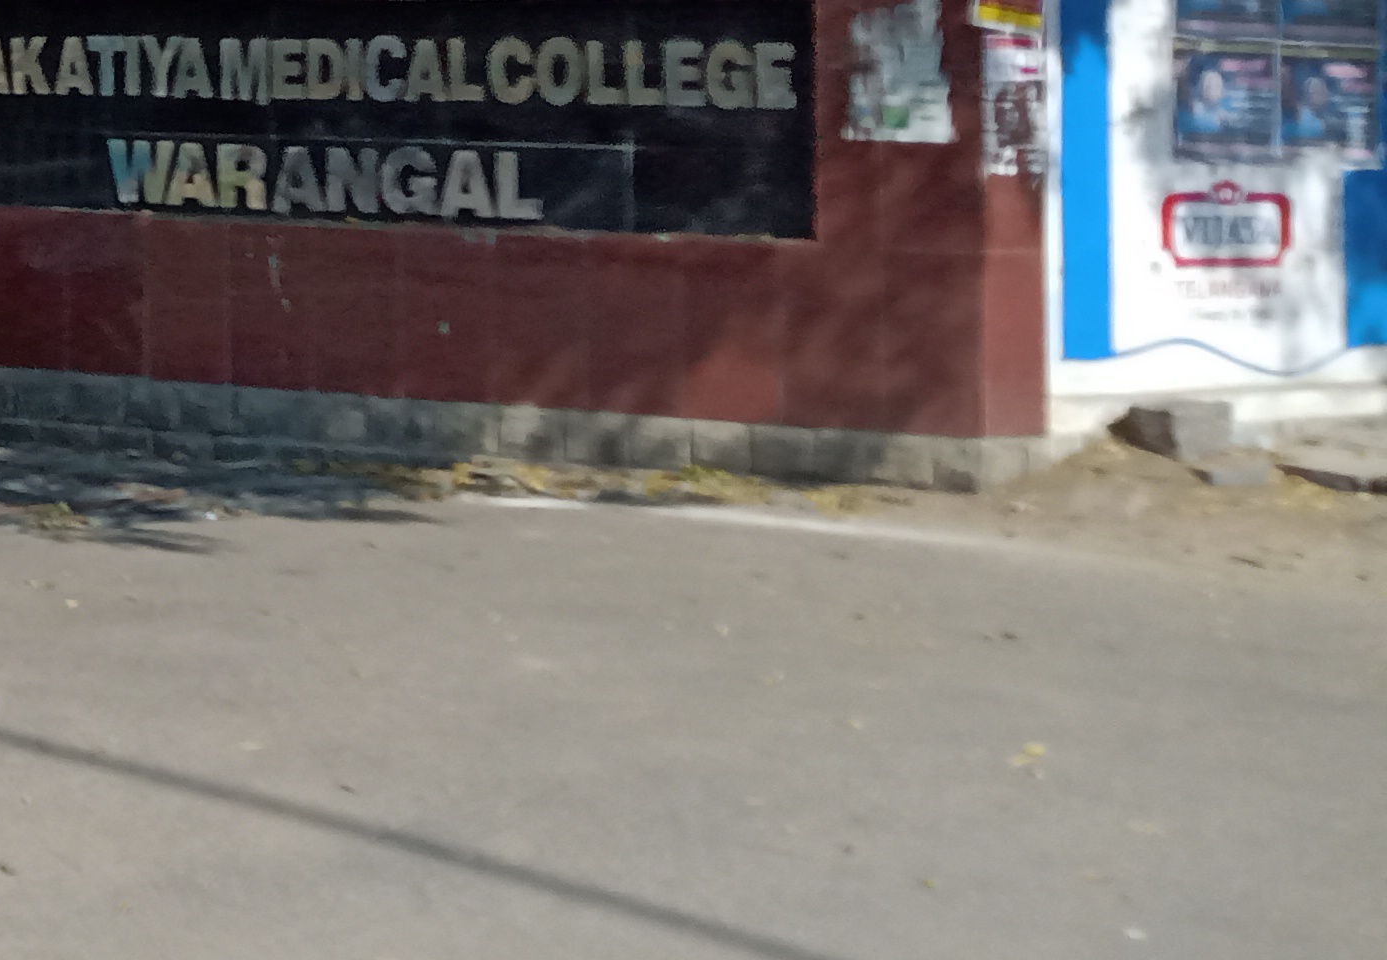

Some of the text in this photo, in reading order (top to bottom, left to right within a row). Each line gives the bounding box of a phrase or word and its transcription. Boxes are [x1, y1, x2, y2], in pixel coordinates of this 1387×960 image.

[220, 34, 485, 105] MEDICAL
[484, 36, 798, 110] COLLEGE
[107, 139, 545, 220] WARANGAL
